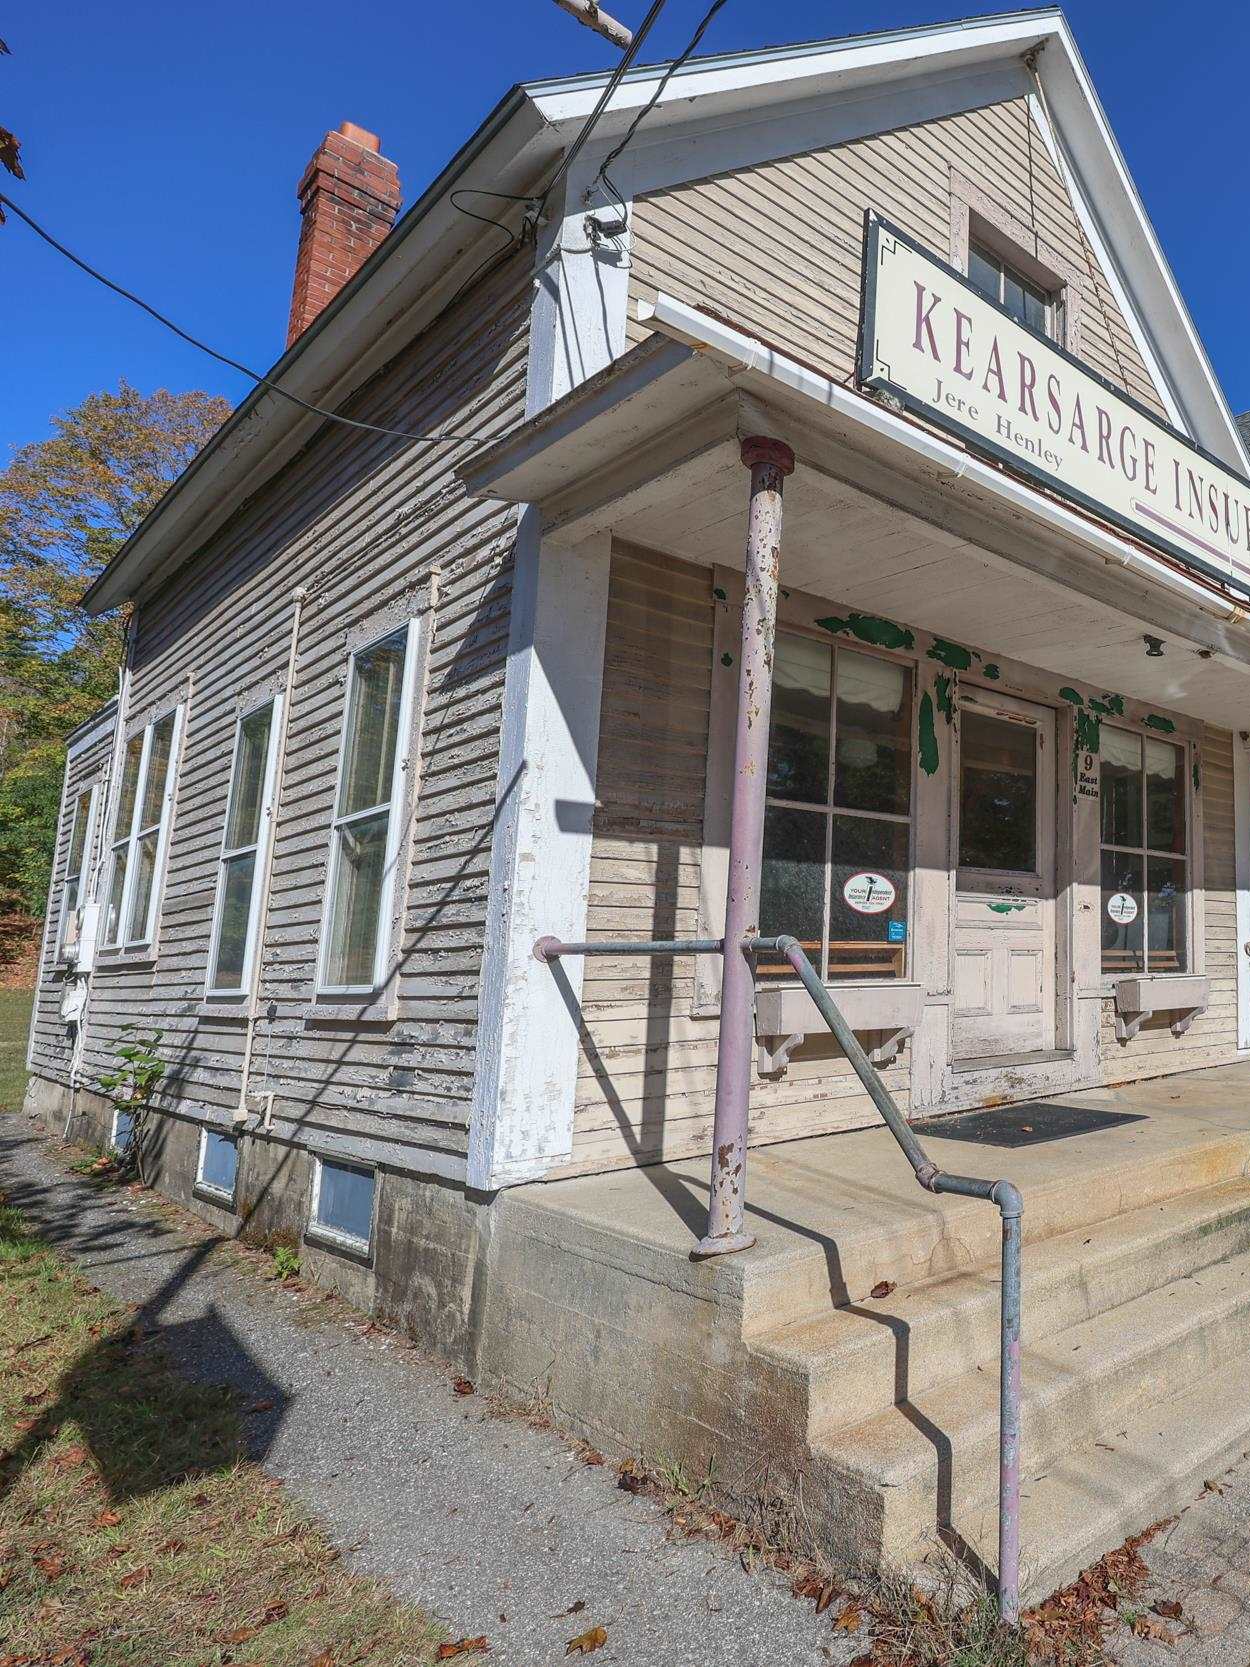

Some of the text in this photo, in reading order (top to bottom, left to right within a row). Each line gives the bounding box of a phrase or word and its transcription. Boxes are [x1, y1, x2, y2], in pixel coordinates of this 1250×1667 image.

[913, 280, 1157, 495] KEARSARGE
[932, 378, 1063, 471] Jere Henley
[1084, 754, 1093, 771] 9
[1079, 772, 1098, 785] East
[1078, 785, 1099, 798] Main
